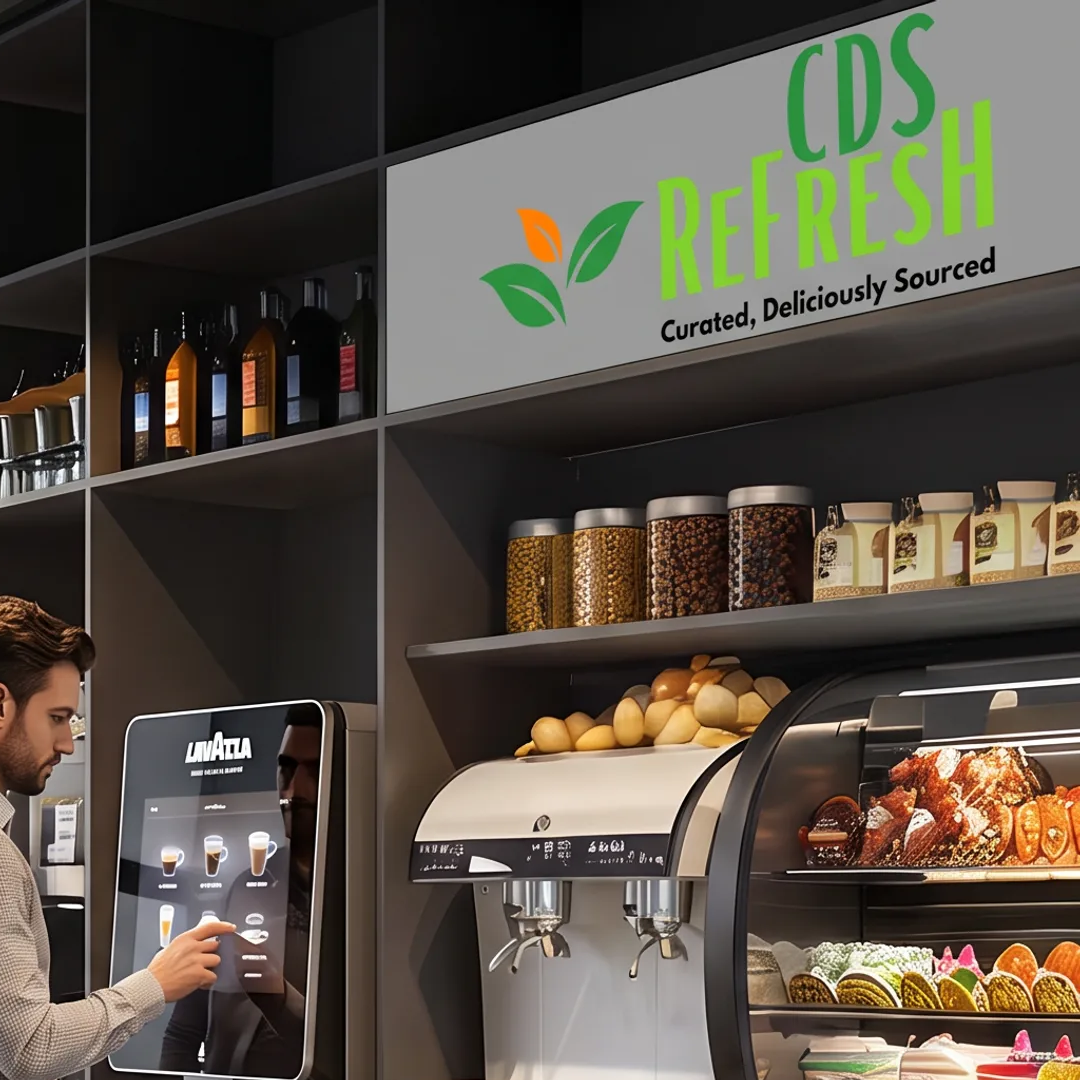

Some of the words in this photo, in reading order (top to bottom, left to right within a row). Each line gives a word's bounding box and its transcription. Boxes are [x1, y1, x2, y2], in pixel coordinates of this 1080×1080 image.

[787, 12, 936, 163] CDS
[660, 301, 757, 343] Curated,
[763, 273, 888, 323] Deliciously
[893, 245, 997, 294] Sourced
[184, 731, 252, 764] LAVAZZA
